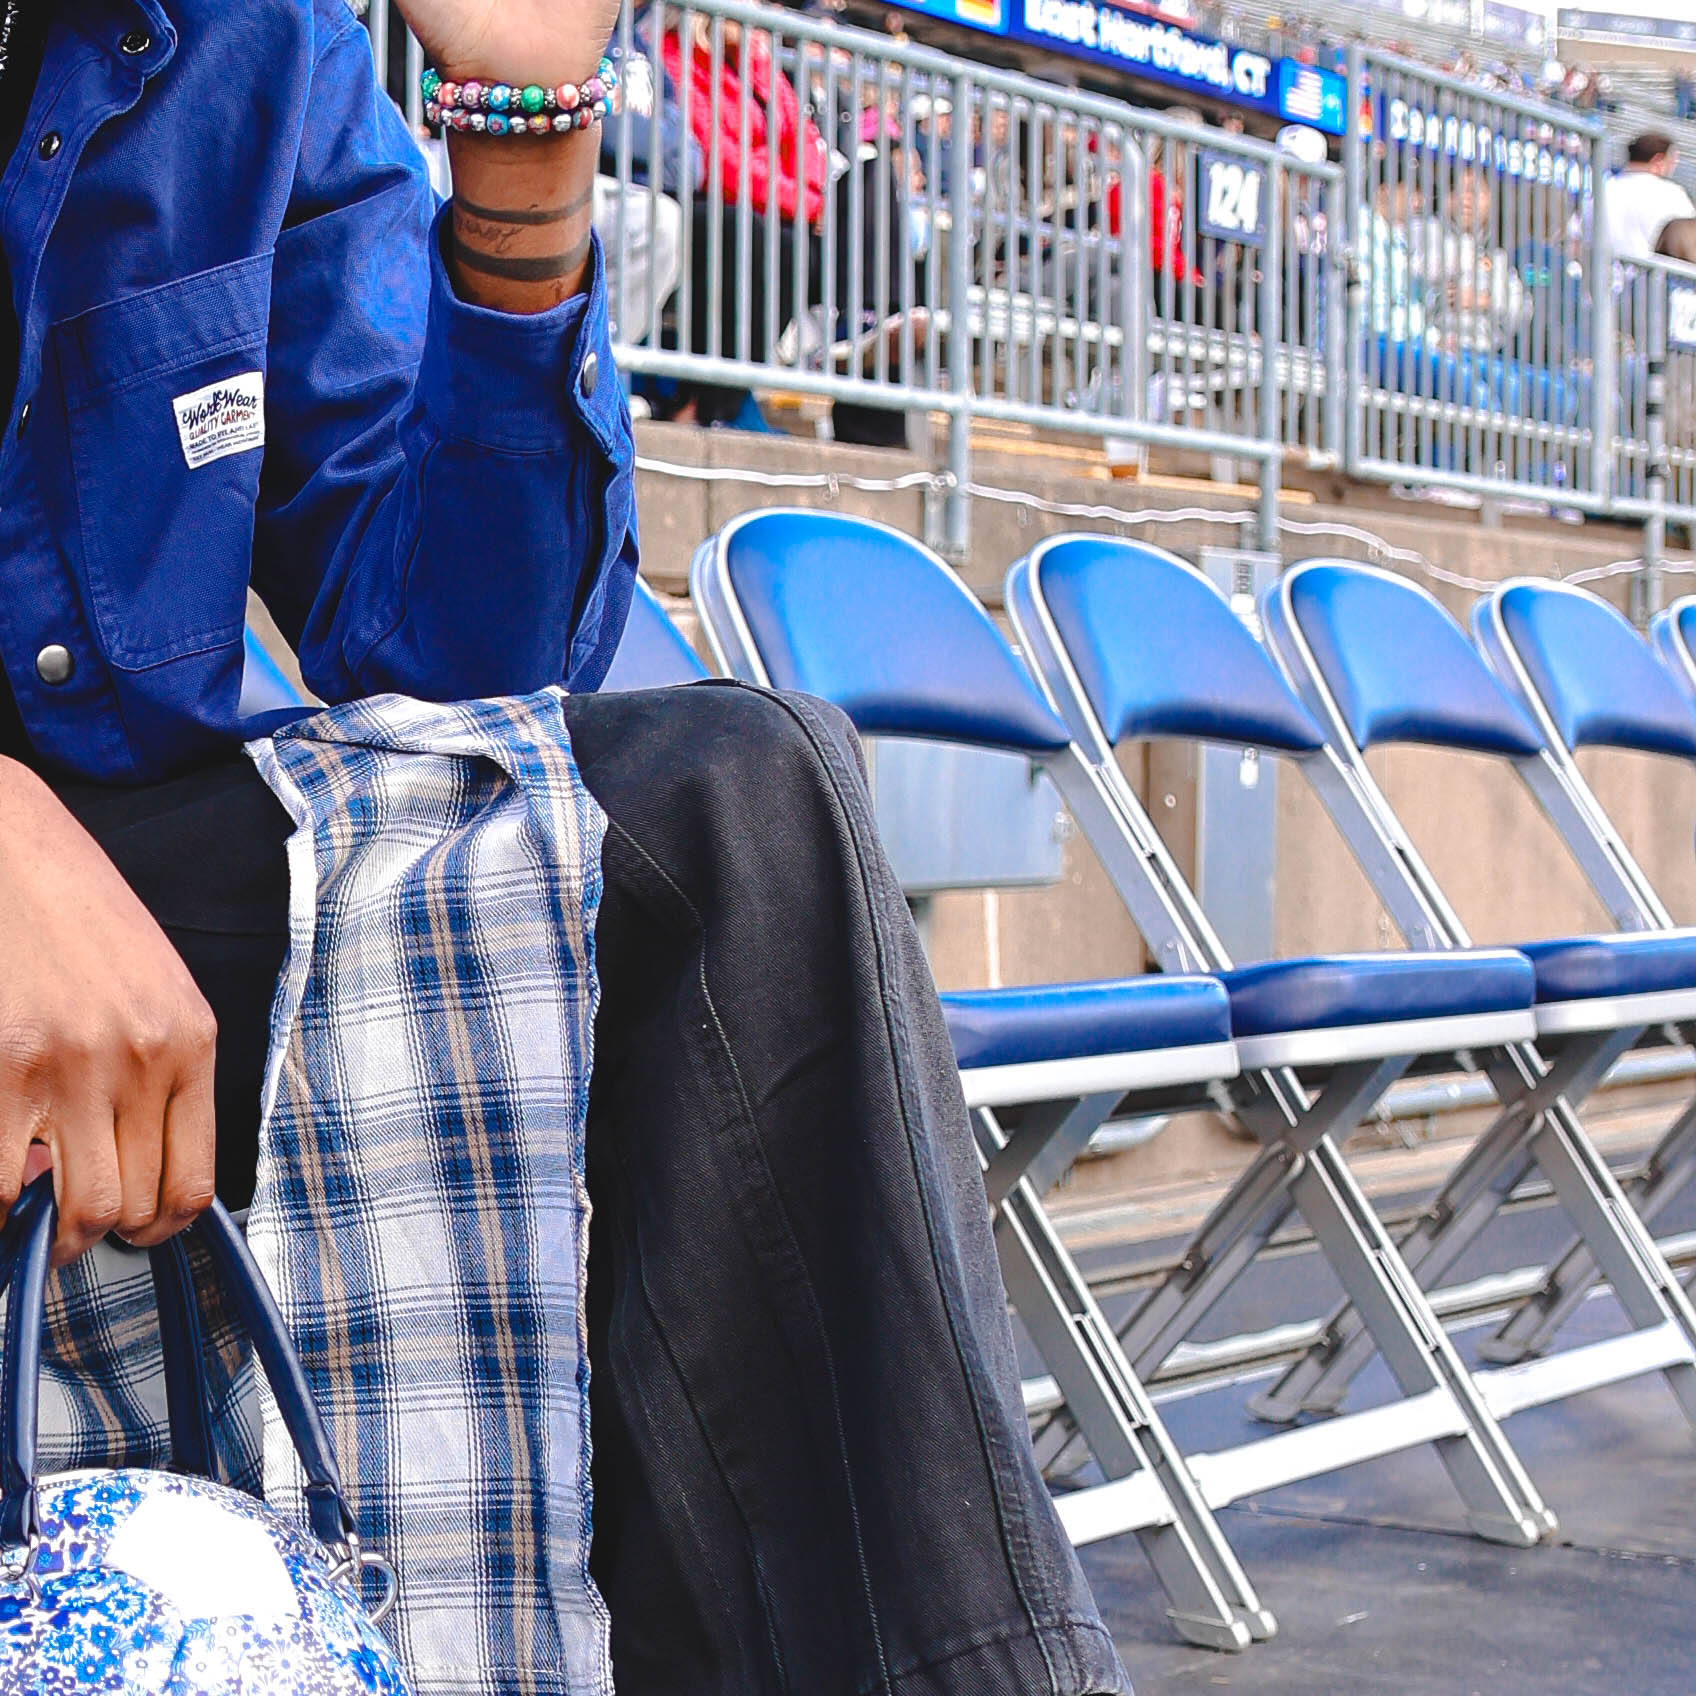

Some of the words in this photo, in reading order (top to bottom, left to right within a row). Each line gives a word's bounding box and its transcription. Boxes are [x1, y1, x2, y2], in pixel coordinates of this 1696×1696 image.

[1232, 52, 1271, 97] CT
[1209, 162, 1260, 234] 124
[189, 415, 219, 440] QUALITY
